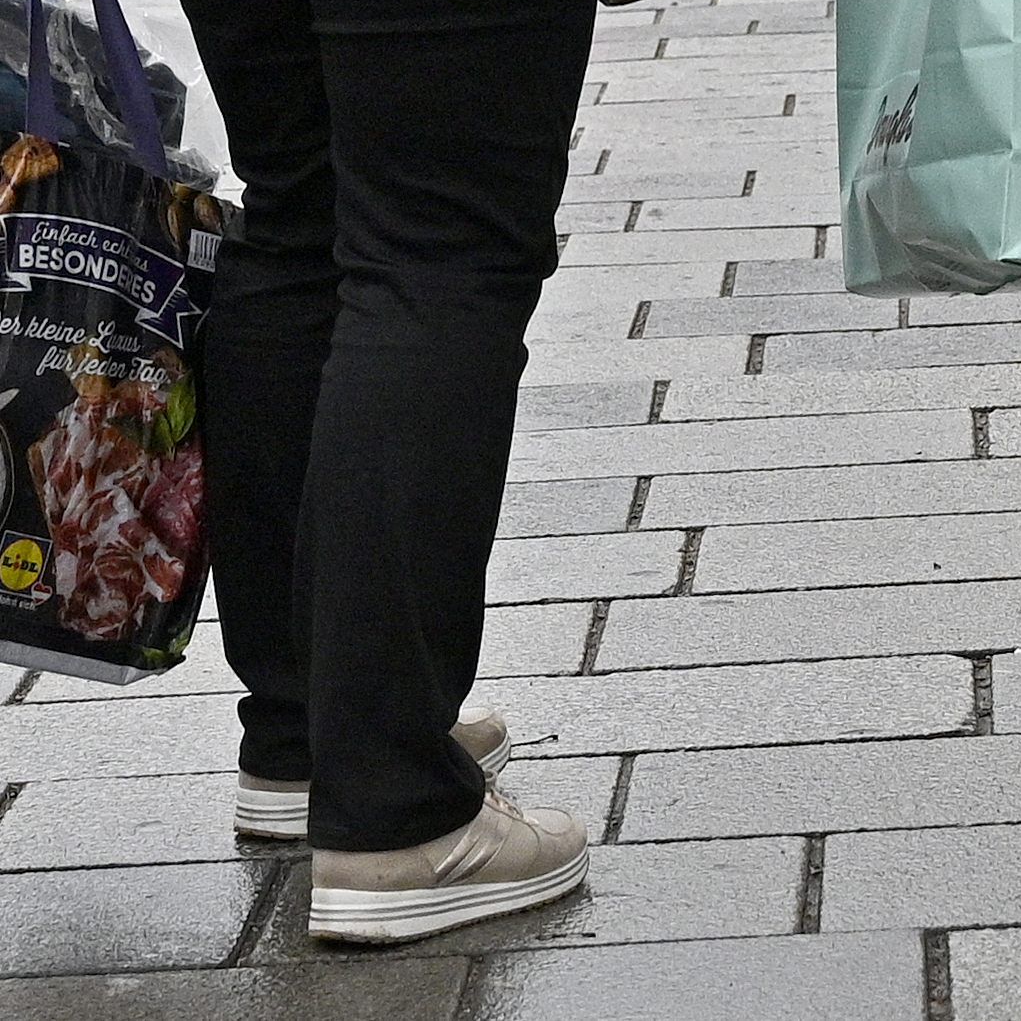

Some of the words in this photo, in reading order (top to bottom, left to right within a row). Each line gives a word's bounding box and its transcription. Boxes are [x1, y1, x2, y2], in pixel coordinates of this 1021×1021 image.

[31, 221, 99, 248] Einfach
[19, 243, 157, 304] BESONDERES
[0, 311, 24, 336] er
[24, 315, 87, 344] kleine
[35, 345, 74, 376] für
[69, 352, 128, 382] jeden
[128, 356, 171, 391] Tag.
